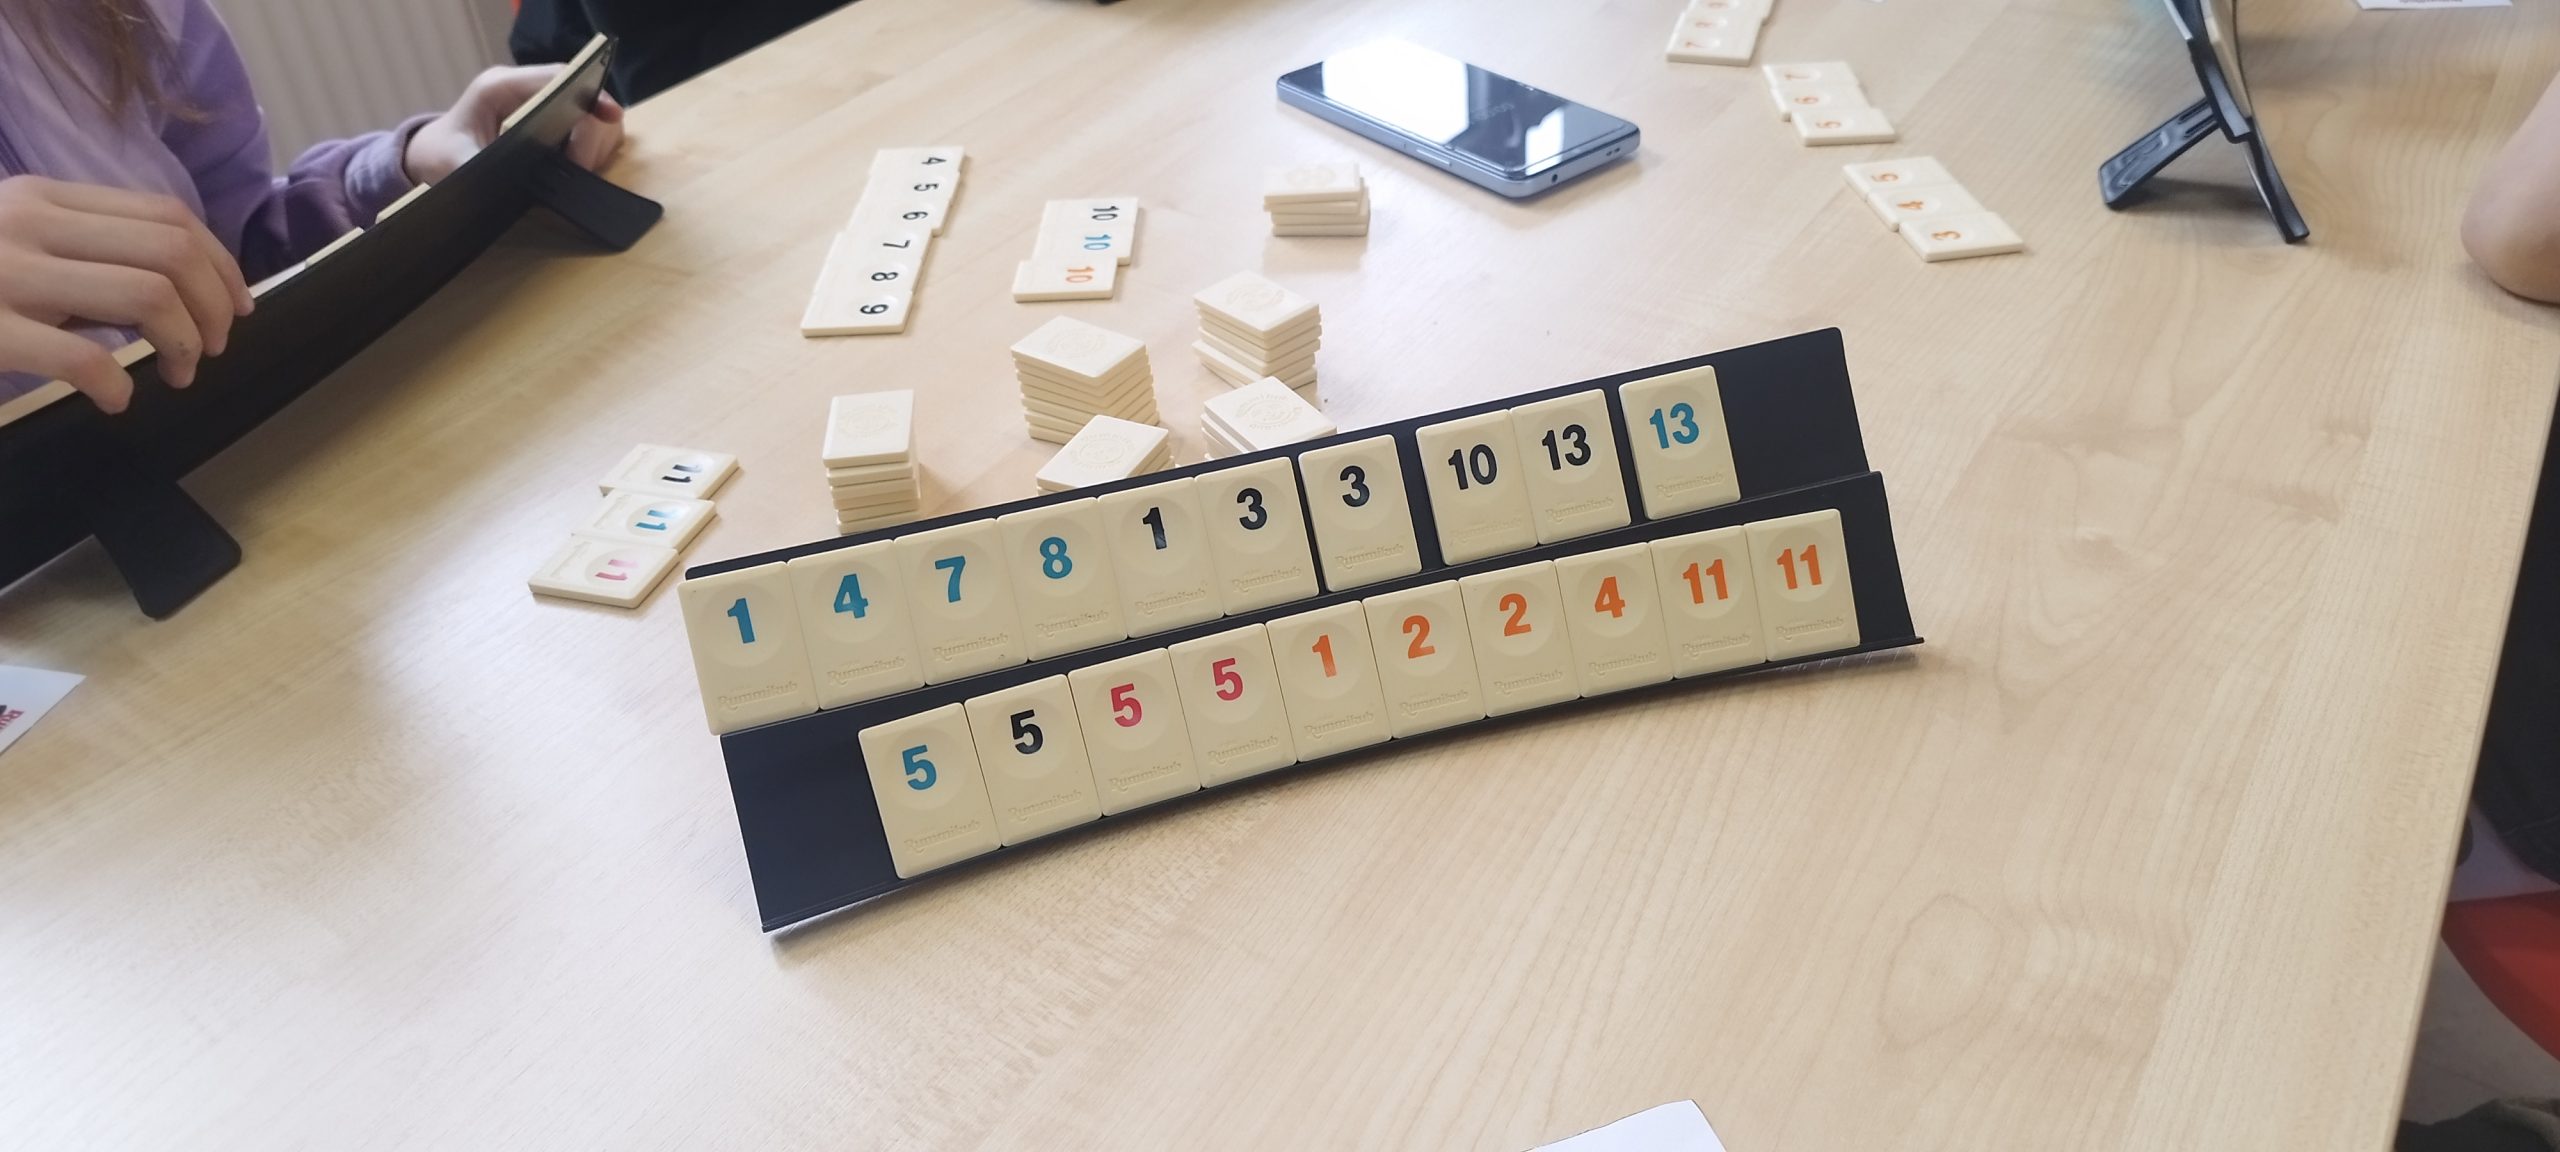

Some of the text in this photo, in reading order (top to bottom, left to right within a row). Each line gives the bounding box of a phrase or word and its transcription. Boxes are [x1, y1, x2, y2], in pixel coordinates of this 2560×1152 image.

[921, 157, 947, 165] 4
[914, 182, 939, 192] 5
[902, 211, 928, 220] 6
[1092, 205, 1120, 221] 10
[883, 239, 911, 249] 7
[1084, 234, 1112, 250] 10
[871, 271, 898, 281] 8
[1066, 266, 1095, 283] 10
[860, 303, 889, 315] 9
[1649, 402, 1700, 449] 13
[1542, 424, 1592, 471] 13
[661, 464, 703, 483] 11
[1447, 444, 1498, 490] 10
[1340, 466, 1371, 508] 3
[1656, 472, 1724, 497] Rummikub
[1237, 488, 1268, 531] 3
[1545, 496, 1614, 523] Rummikub
[1142, 507, 1168, 550] 1
[595, 559, 639, 581] 11
[1040, 536, 1073, 580] 8
[1335, 543, 1403, 569] Rummikub
[1777, 544, 1822, 590] 11
[935, 556, 967, 603] 7
[1232, 566, 1301, 592] Rummikub
[1683, 559, 1729, 605] 11
[834, 573, 868, 619] 4
[1135, 585, 1206, 615] Rummikub
[1594, 577, 1626, 618] 4
[727, 598, 755, 643] 1
[1035, 609, 1109, 638] Rummikub
[1499, 593, 1532, 637] 2
[1776, 616, 1845, 641] Rummikub
[933, 632, 1009, 662] Rummikub
[1403, 615, 1435, 659] 2
[1682, 633, 1750, 657] Rummikub
[826, 656, 905, 686] Rummikub
[1311, 635, 1335, 677] 1
[1588, 651, 1656, 678] Rummikub
[1212, 658, 1243, 701] 5
[1494, 669, 1563, 696] Rummikub
[717, 681, 798, 711] Rummikub
[1111, 683, 1142, 727] 5
[1400, 689, 1469, 718] Rummikub
[1010, 709, 1044, 754] 5
[1304, 711, 1374, 738] Rummikub
[1208, 734, 1279, 764] Rummikub
[902, 745, 936, 790] 5
[1110, 760, 1182, 792] Rummikub
[1008, 789, 1082, 822] Rummikub
[904, 820, 981, 853] Rummikub
